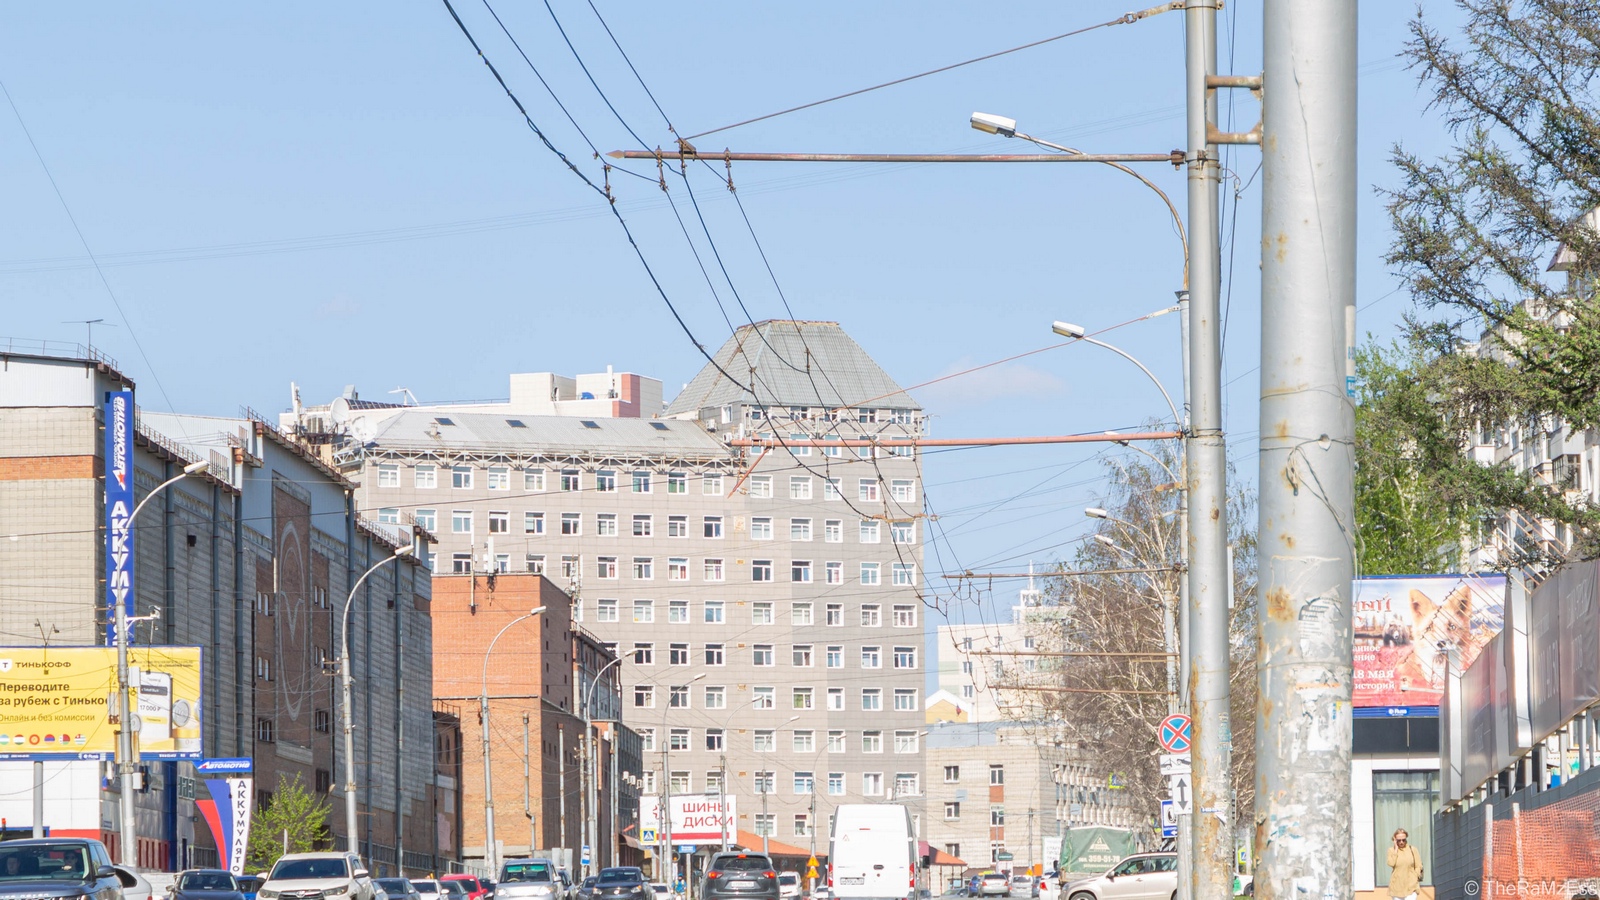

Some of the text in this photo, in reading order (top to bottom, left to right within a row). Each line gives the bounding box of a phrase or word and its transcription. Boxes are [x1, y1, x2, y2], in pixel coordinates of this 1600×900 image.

[113, 397, 126, 491] АВТОМОТИВ
[1368, 670, 1395, 679] мая
[0, 683, 70, 693] Переводите
[1355, 682, 1396, 692] историй
[13, 696, 50, 707] рубеж
[198, 760, 251, 770] АВТОМОТИВ
[683, 802, 730, 813] ШИНЫ
[232, 780, 247, 872] АККУМУЛЯТО
[683, 816, 733, 829] ДИСКИ
